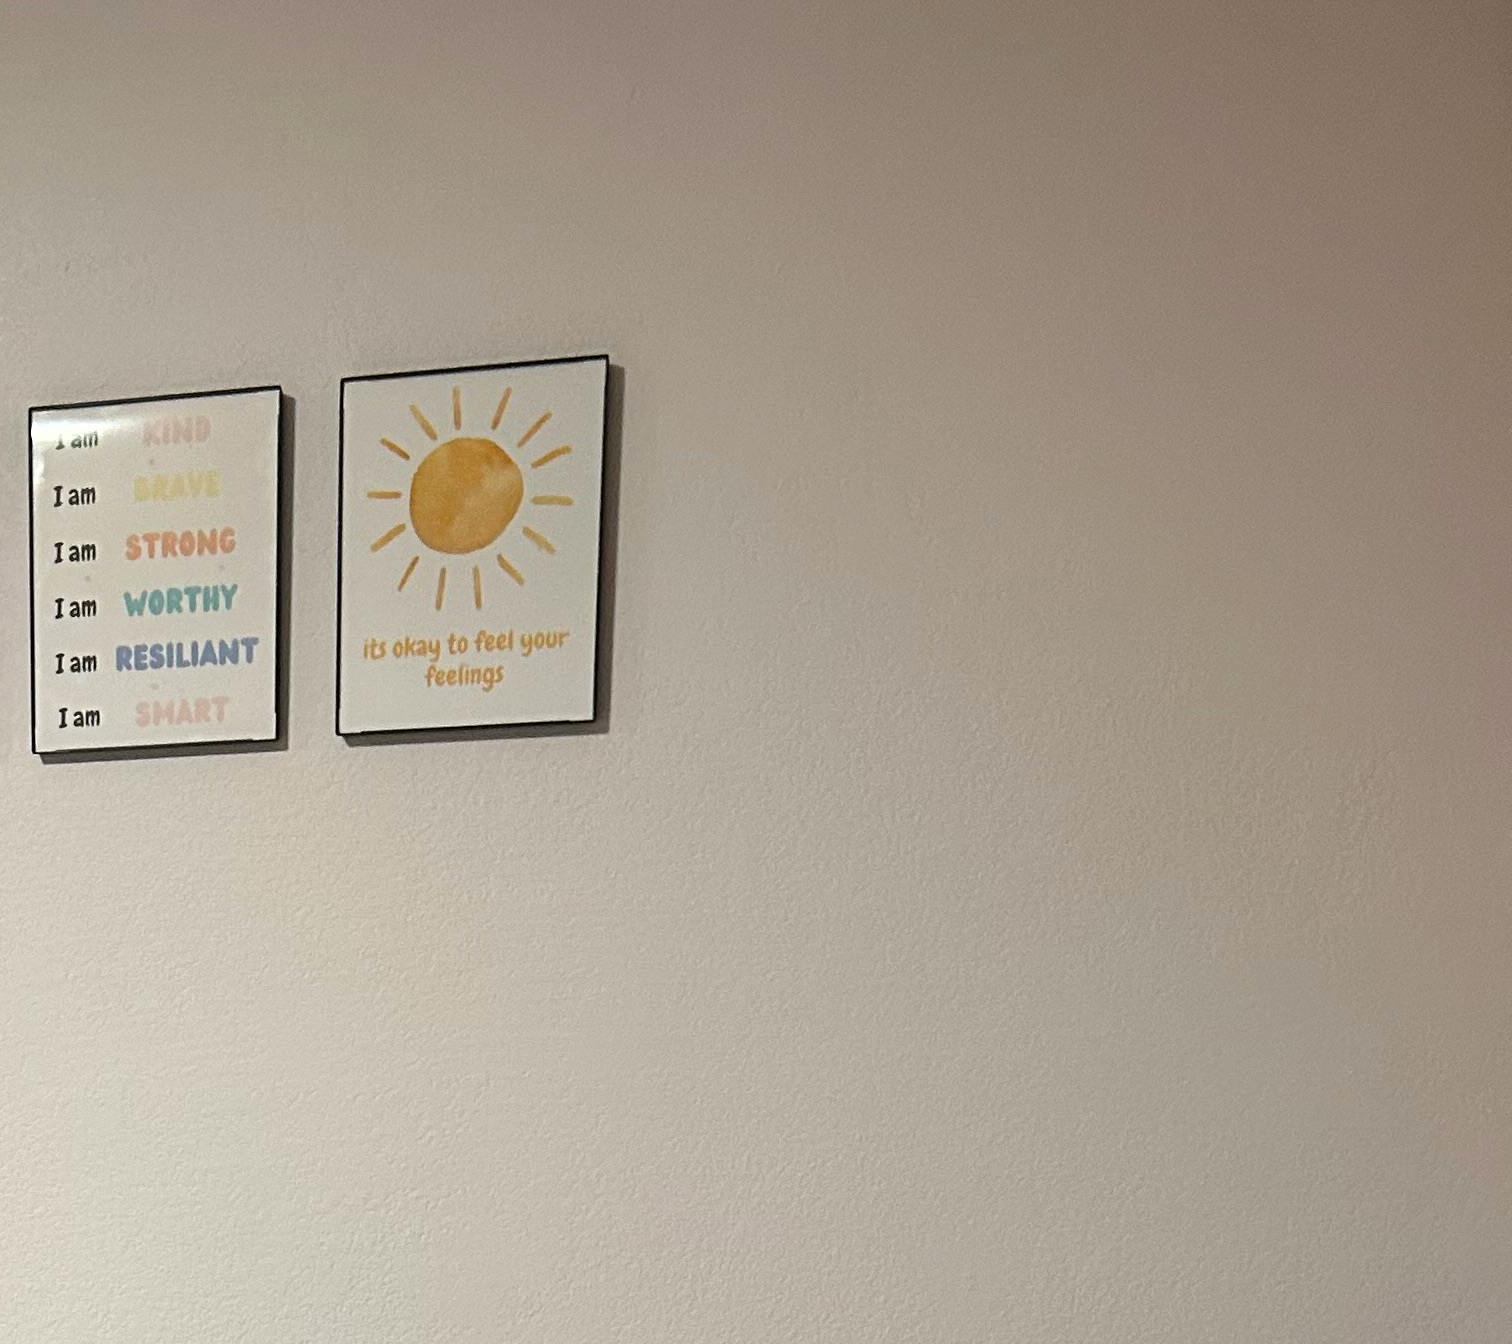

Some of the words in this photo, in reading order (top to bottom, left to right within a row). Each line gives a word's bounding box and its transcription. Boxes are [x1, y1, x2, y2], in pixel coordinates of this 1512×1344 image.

[70, 431, 99, 449] am
[142, 415, 212, 446] KIND
[53, 485, 64, 508] I
[68, 487, 96, 506] am
[134, 468, 222, 502] BRAVE
[54, 542, 65, 564] I
[69, 543, 96, 562] am
[125, 526, 237, 561] STRONG
[55, 598, 65, 619] I
[69, 599, 97, 618] am
[123, 583, 238, 617] WORTHY
[55, 653, 65, 674] I
[70, 654, 97, 673] am
[115, 637, 260, 672] RESILIANT
[363, 637, 387, 660] its
[392, 636, 441, 662] okay
[447, 633, 469, 655] to
[474, 629, 514, 652] feel
[520, 630, 570, 657] your
[425, 664, 504, 693] feelings
[58, 708, 68, 728] I
[73, 709, 101, 727] am
[135, 696, 230, 727] SMART
